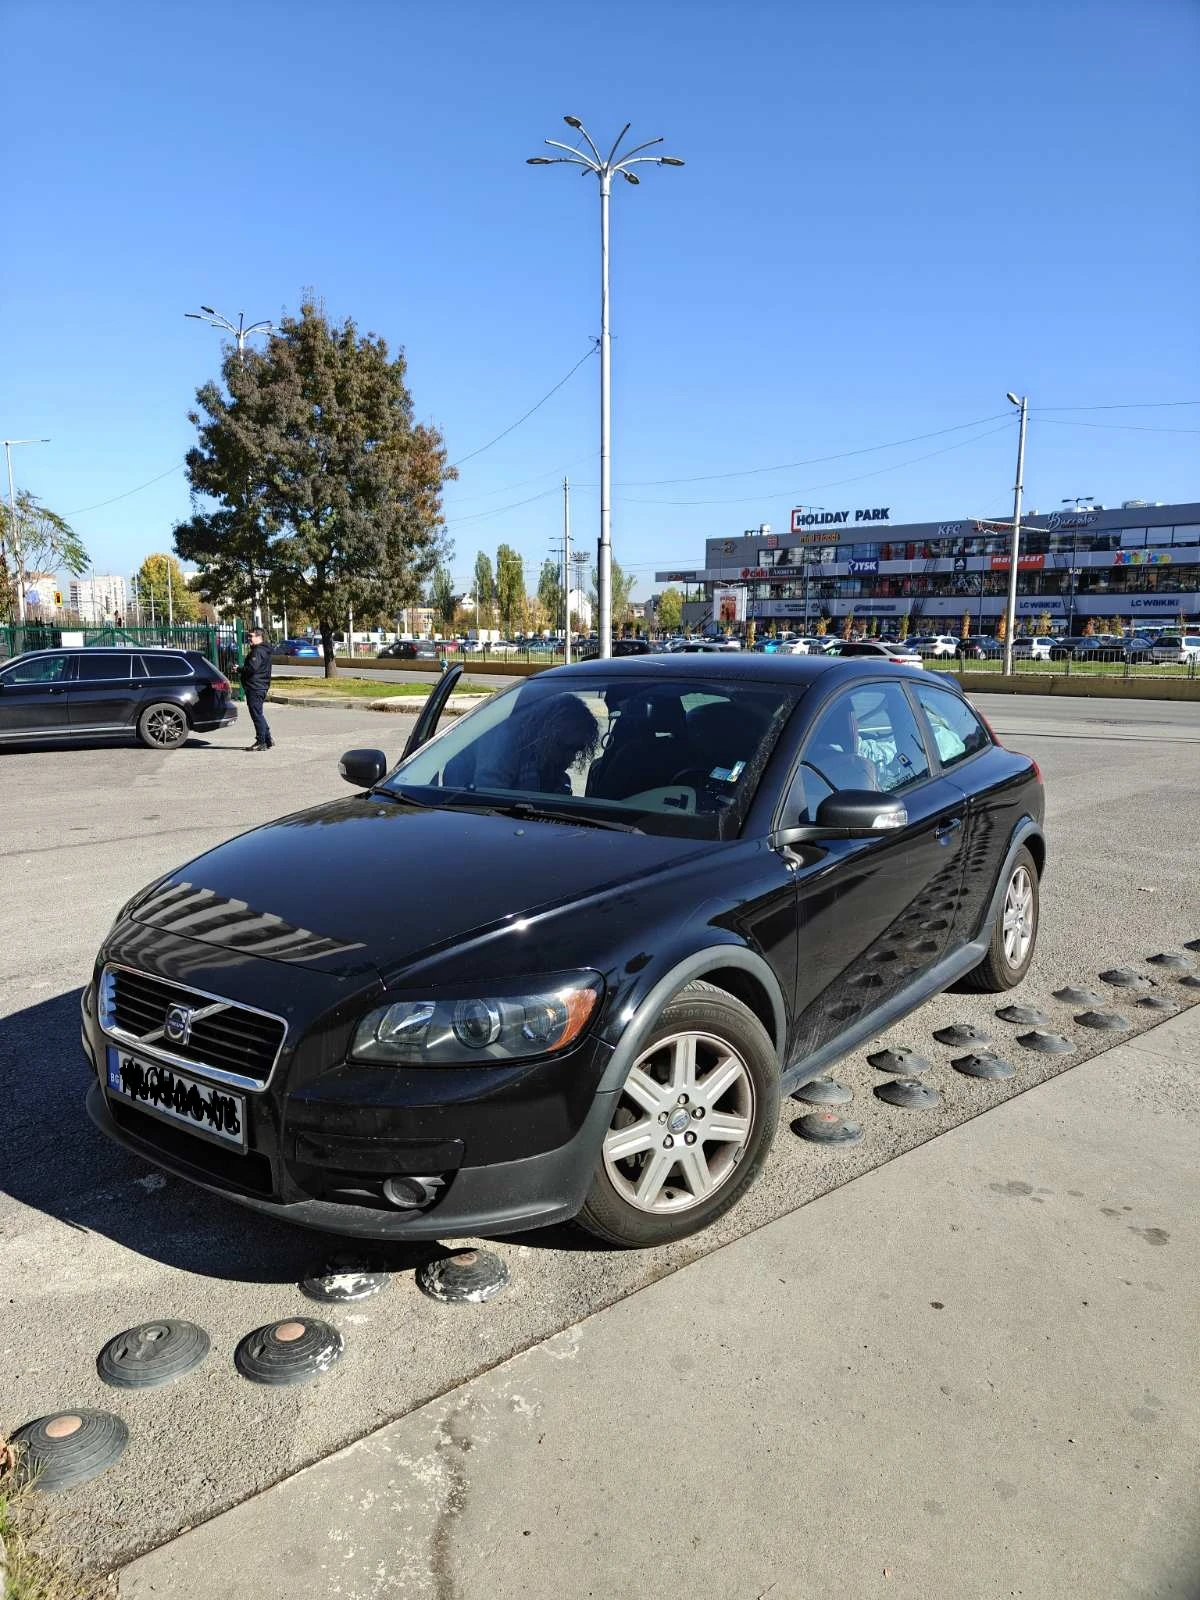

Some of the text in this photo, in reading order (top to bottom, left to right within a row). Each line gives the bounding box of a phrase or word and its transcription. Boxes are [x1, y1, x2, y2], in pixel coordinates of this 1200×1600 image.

[797, 507, 890, 526] HOLIDAY PARK
[938, 525, 961, 535] KFC
[853, 561, 877, 571] JYSK
[1019, 601, 1029, 609] LC
[1131, 599, 1142, 607] LC
[110, 1072, 120, 1084] BG
